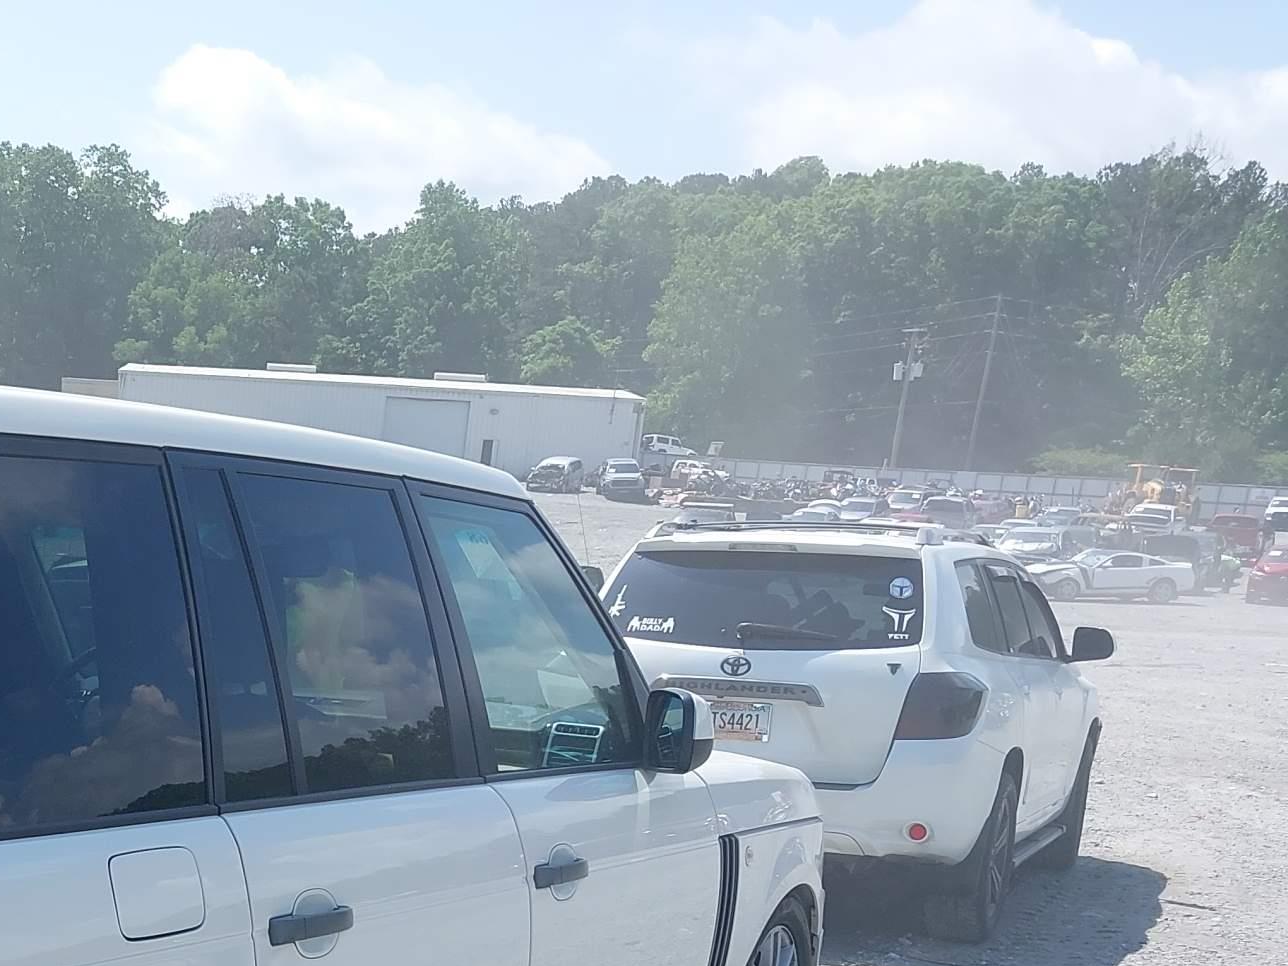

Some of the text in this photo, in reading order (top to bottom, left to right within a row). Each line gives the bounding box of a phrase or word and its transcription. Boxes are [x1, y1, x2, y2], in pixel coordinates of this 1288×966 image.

[642, 617, 663, 625] BULLY
[640, 624, 661, 632] DAD
[664, 680, 796, 696] HIGHLANDER
